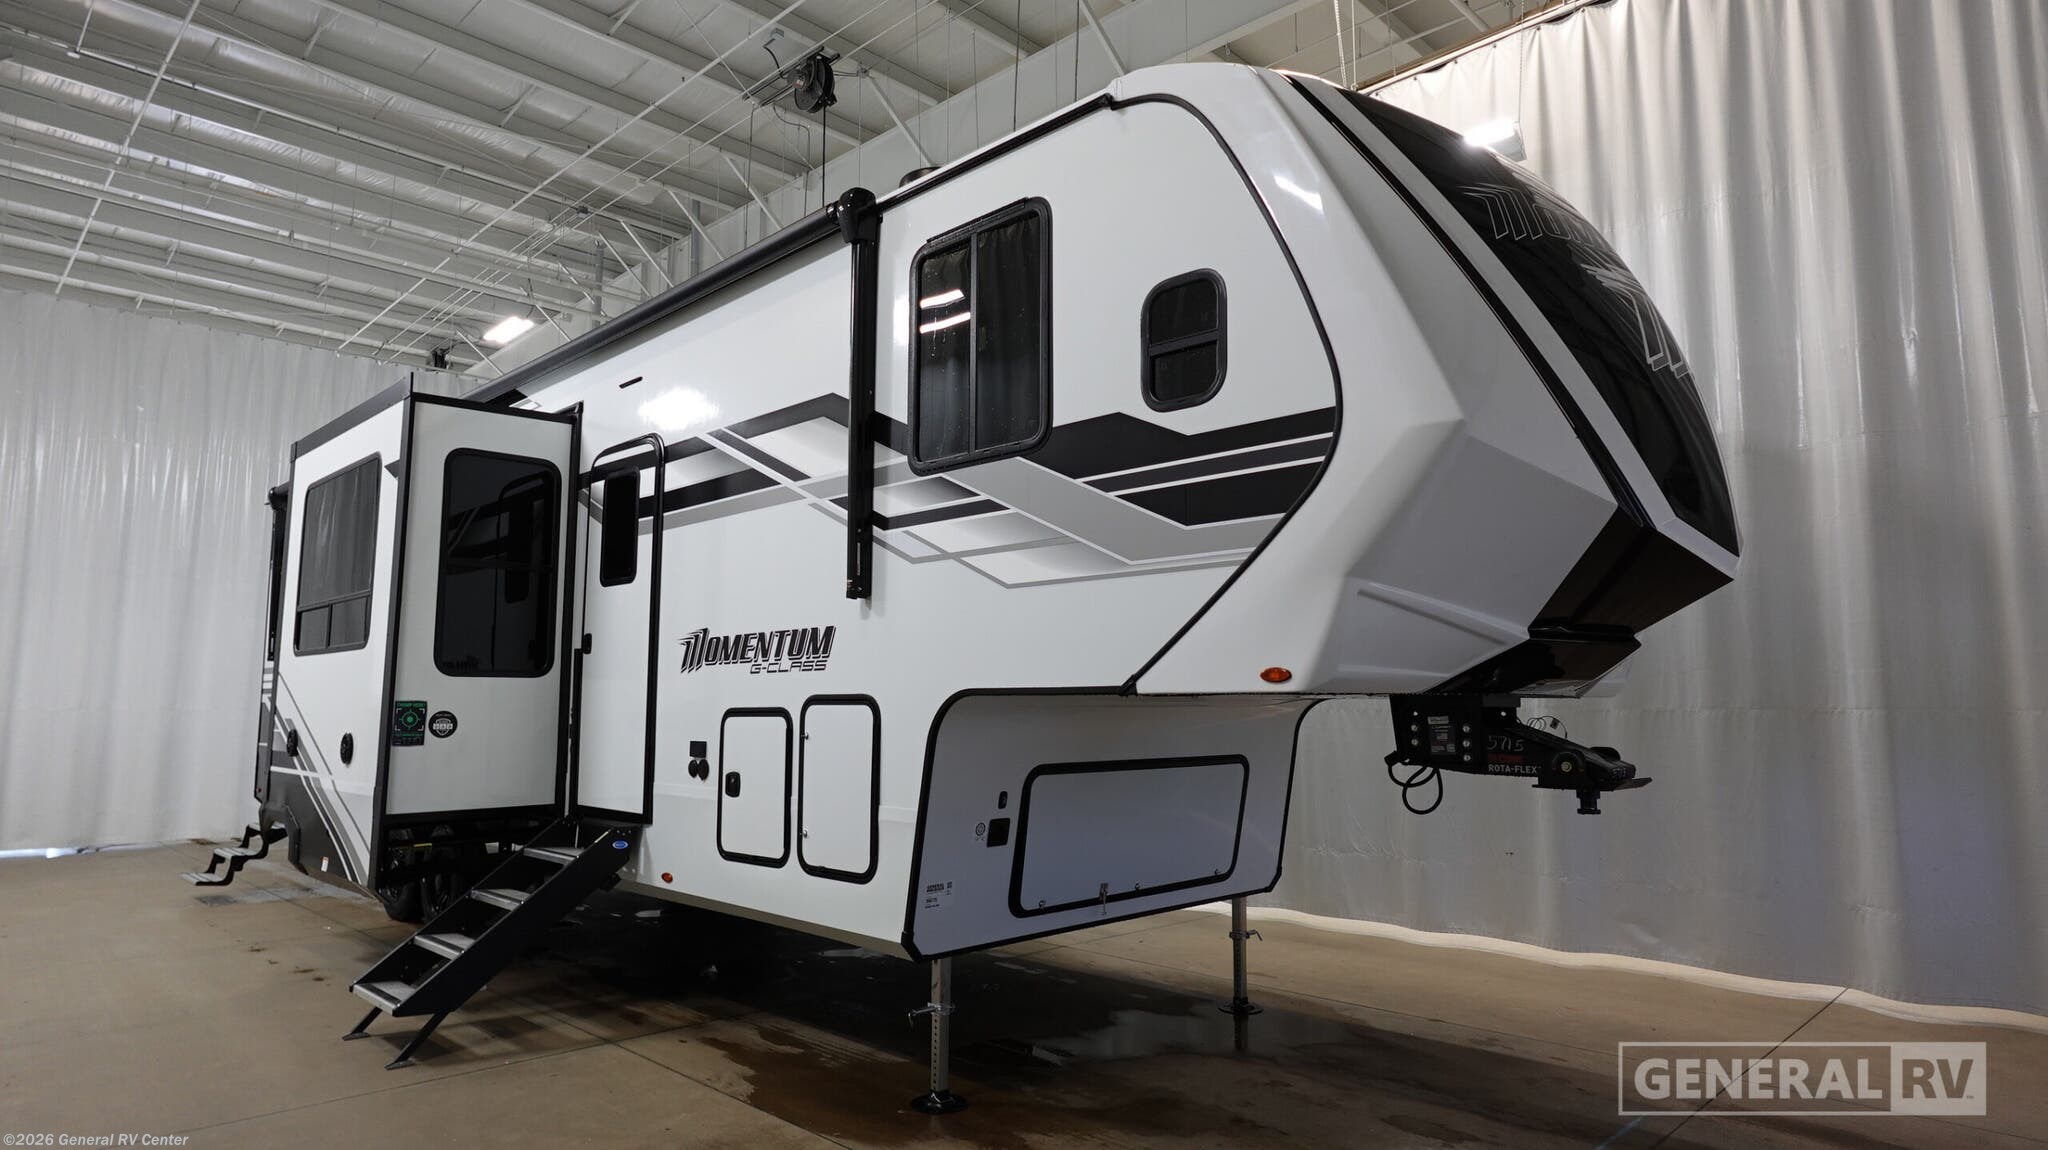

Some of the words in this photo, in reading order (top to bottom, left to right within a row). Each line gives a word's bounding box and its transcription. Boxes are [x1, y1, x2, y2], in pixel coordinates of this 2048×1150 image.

[677, 626, 836, 674] MOMENTUM
[750, 660, 828, 674] G-CLASS
[1488, 764, 1538, 774] ROTA-FLEX
